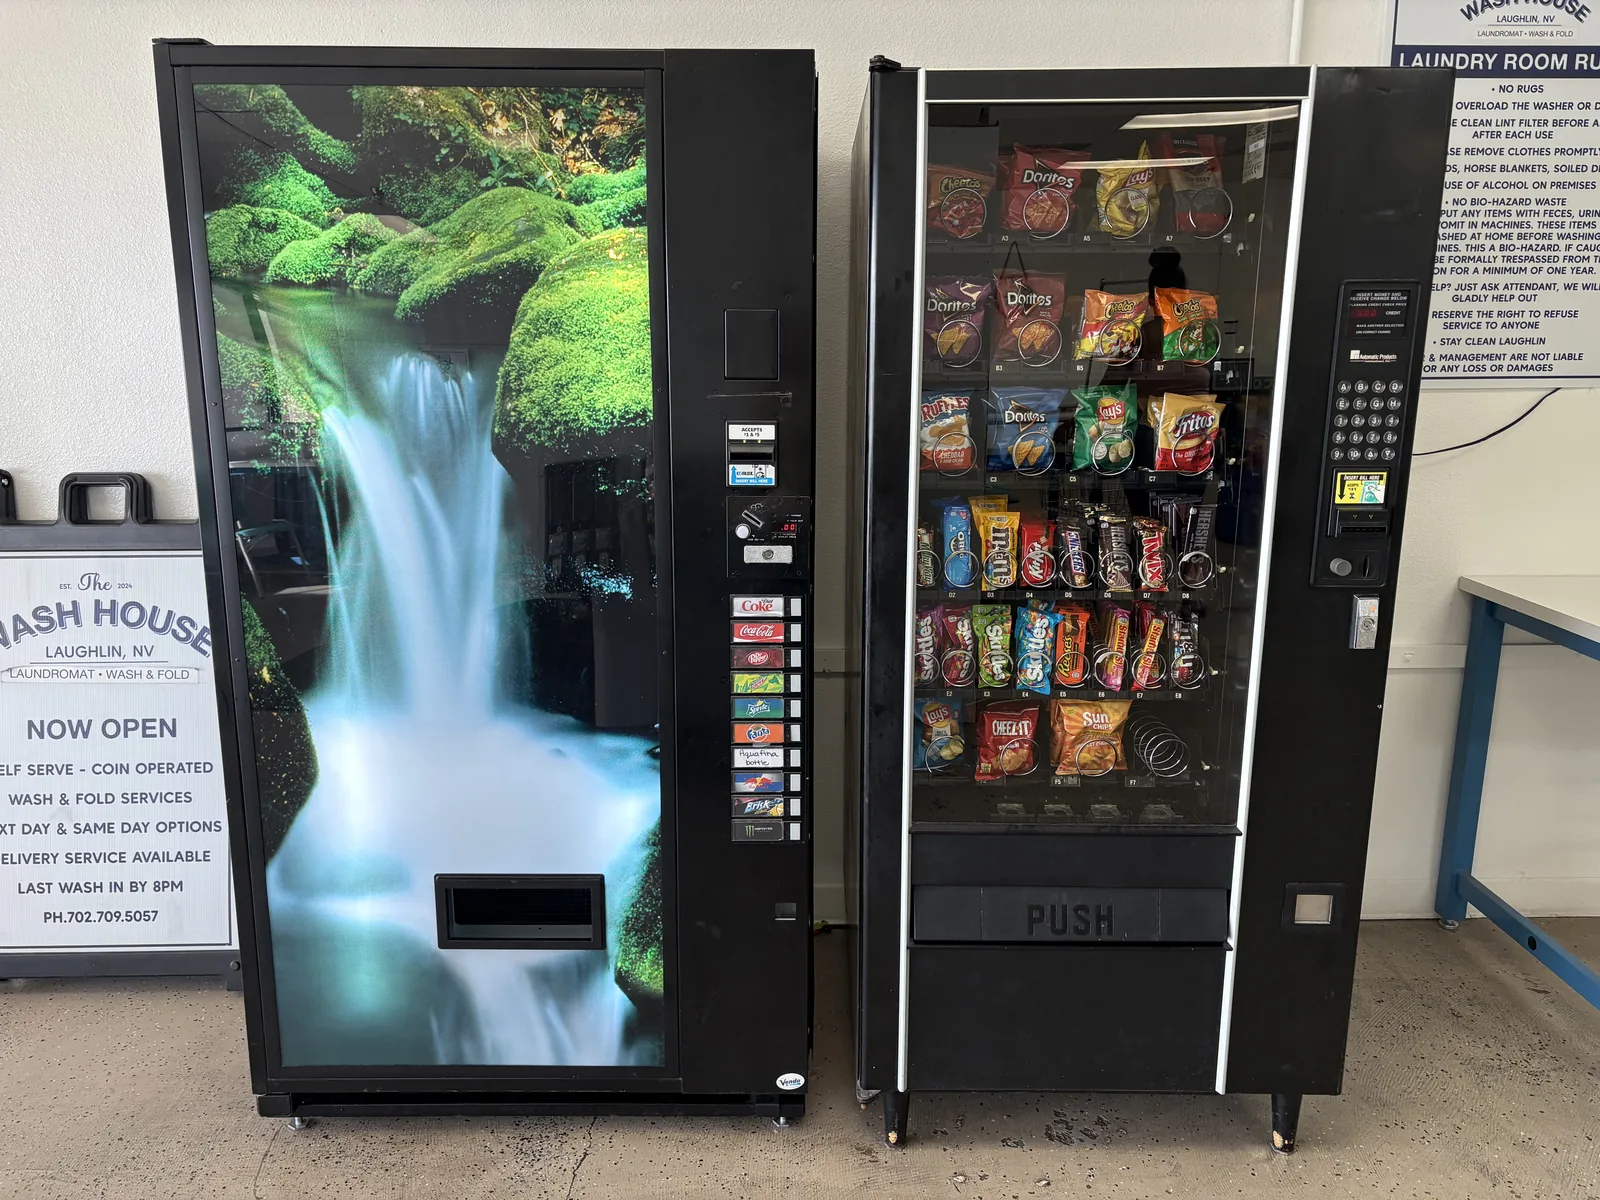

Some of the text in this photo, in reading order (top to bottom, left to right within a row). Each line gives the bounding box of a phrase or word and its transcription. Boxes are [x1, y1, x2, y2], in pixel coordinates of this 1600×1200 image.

[1497, 15, 1540, 24] LAUGHLIN,
[1400, 53, 1498, 70] LAUNDRY
[1504, 54, 1568, 70] ROOM
[1534, 102, 1573, 110] WASHER
[1578, 102, 1591, 110] OR
[1500, 165, 1549, 174] BLANKETS,
[1022, 170, 1075, 188] Doritos
[1544, 210, 1574, 219] FECES,
[1503, 283, 1559, 292] ATTENDANT,
[927, 299, 976, 312] Doritos
[1007, 292, 1052, 306] Doritos
[1429, 354, 1435, 362] &
[1005, 410, 1046, 423] Doritos
[1174, 414, 1215, 438] Fritos
[78, 572, 112, 591] The
[742, 600, 773, 612] Coke
[46, 646, 154, 659] LAUGHLIN, NV
[10, 669, 189, 679] LAUNDROMAT WASH & FOLD
[28, 718, 176, 739] NOW OPEN
[28, 764, 73, 775] SERVE
[92, 764, 129, 774] COIN
[136, 762, 213, 774] OPERATED
[9, 792, 192, 805] WASH & FOLD SERVICES
[22, 824, 50, 834] DAY
[57, 823, 67, 835] &
[74, 823, 114, 834] SAME
[122, 822, 150, 833] DAY
[156, 821, 222, 832] OPTIONS
[65, 852, 126, 864] SERVICE
[132, 851, 210, 862] AVAILABLE
[18, 881, 182, 894] LAST WASH IN BY 8PM
[44, 910, 158, 923] PH.702.709.5057
[1027, 904, 1114, 936] PUSH
